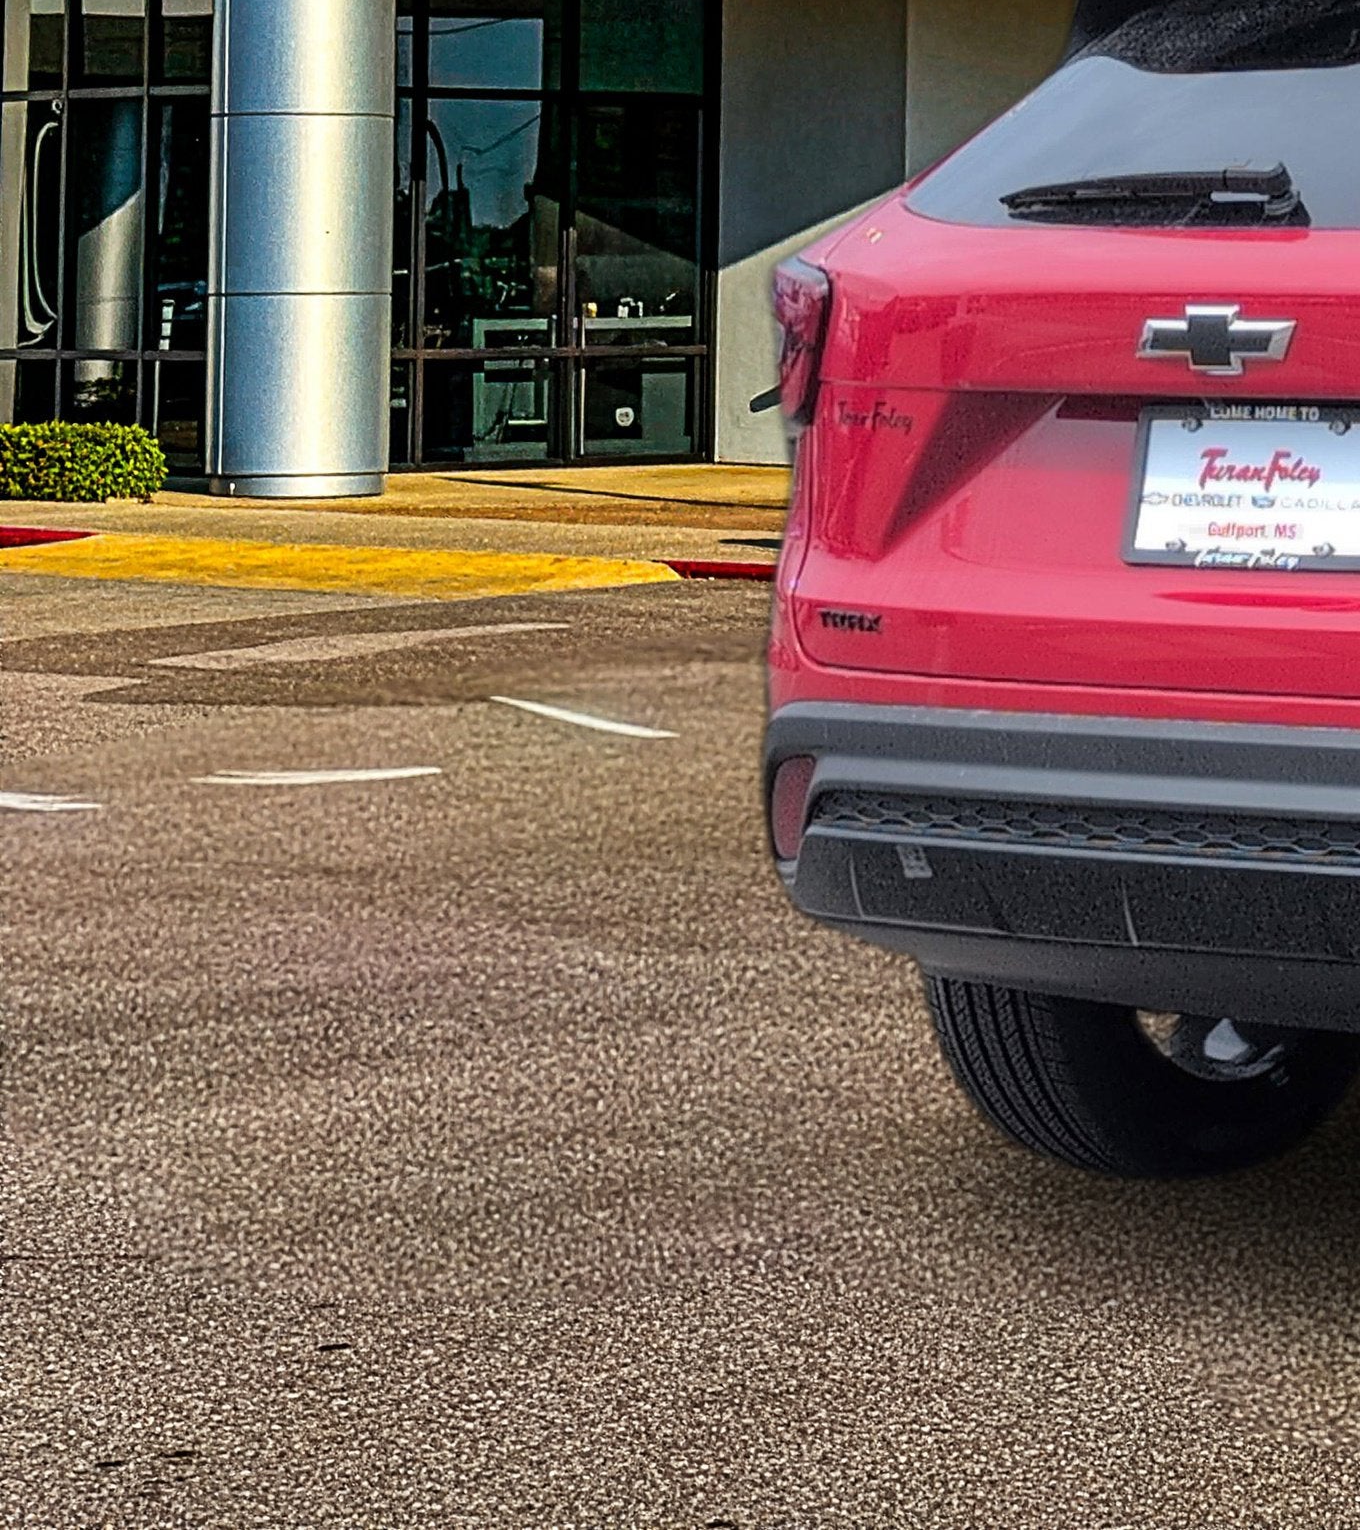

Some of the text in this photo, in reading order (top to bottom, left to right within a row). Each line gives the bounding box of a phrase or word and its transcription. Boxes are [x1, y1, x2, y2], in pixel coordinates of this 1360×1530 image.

[1254, 406, 1298, 421] HOME
[1299, 407, 1320, 421] TO
[1274, 523, 1298, 540] MS
